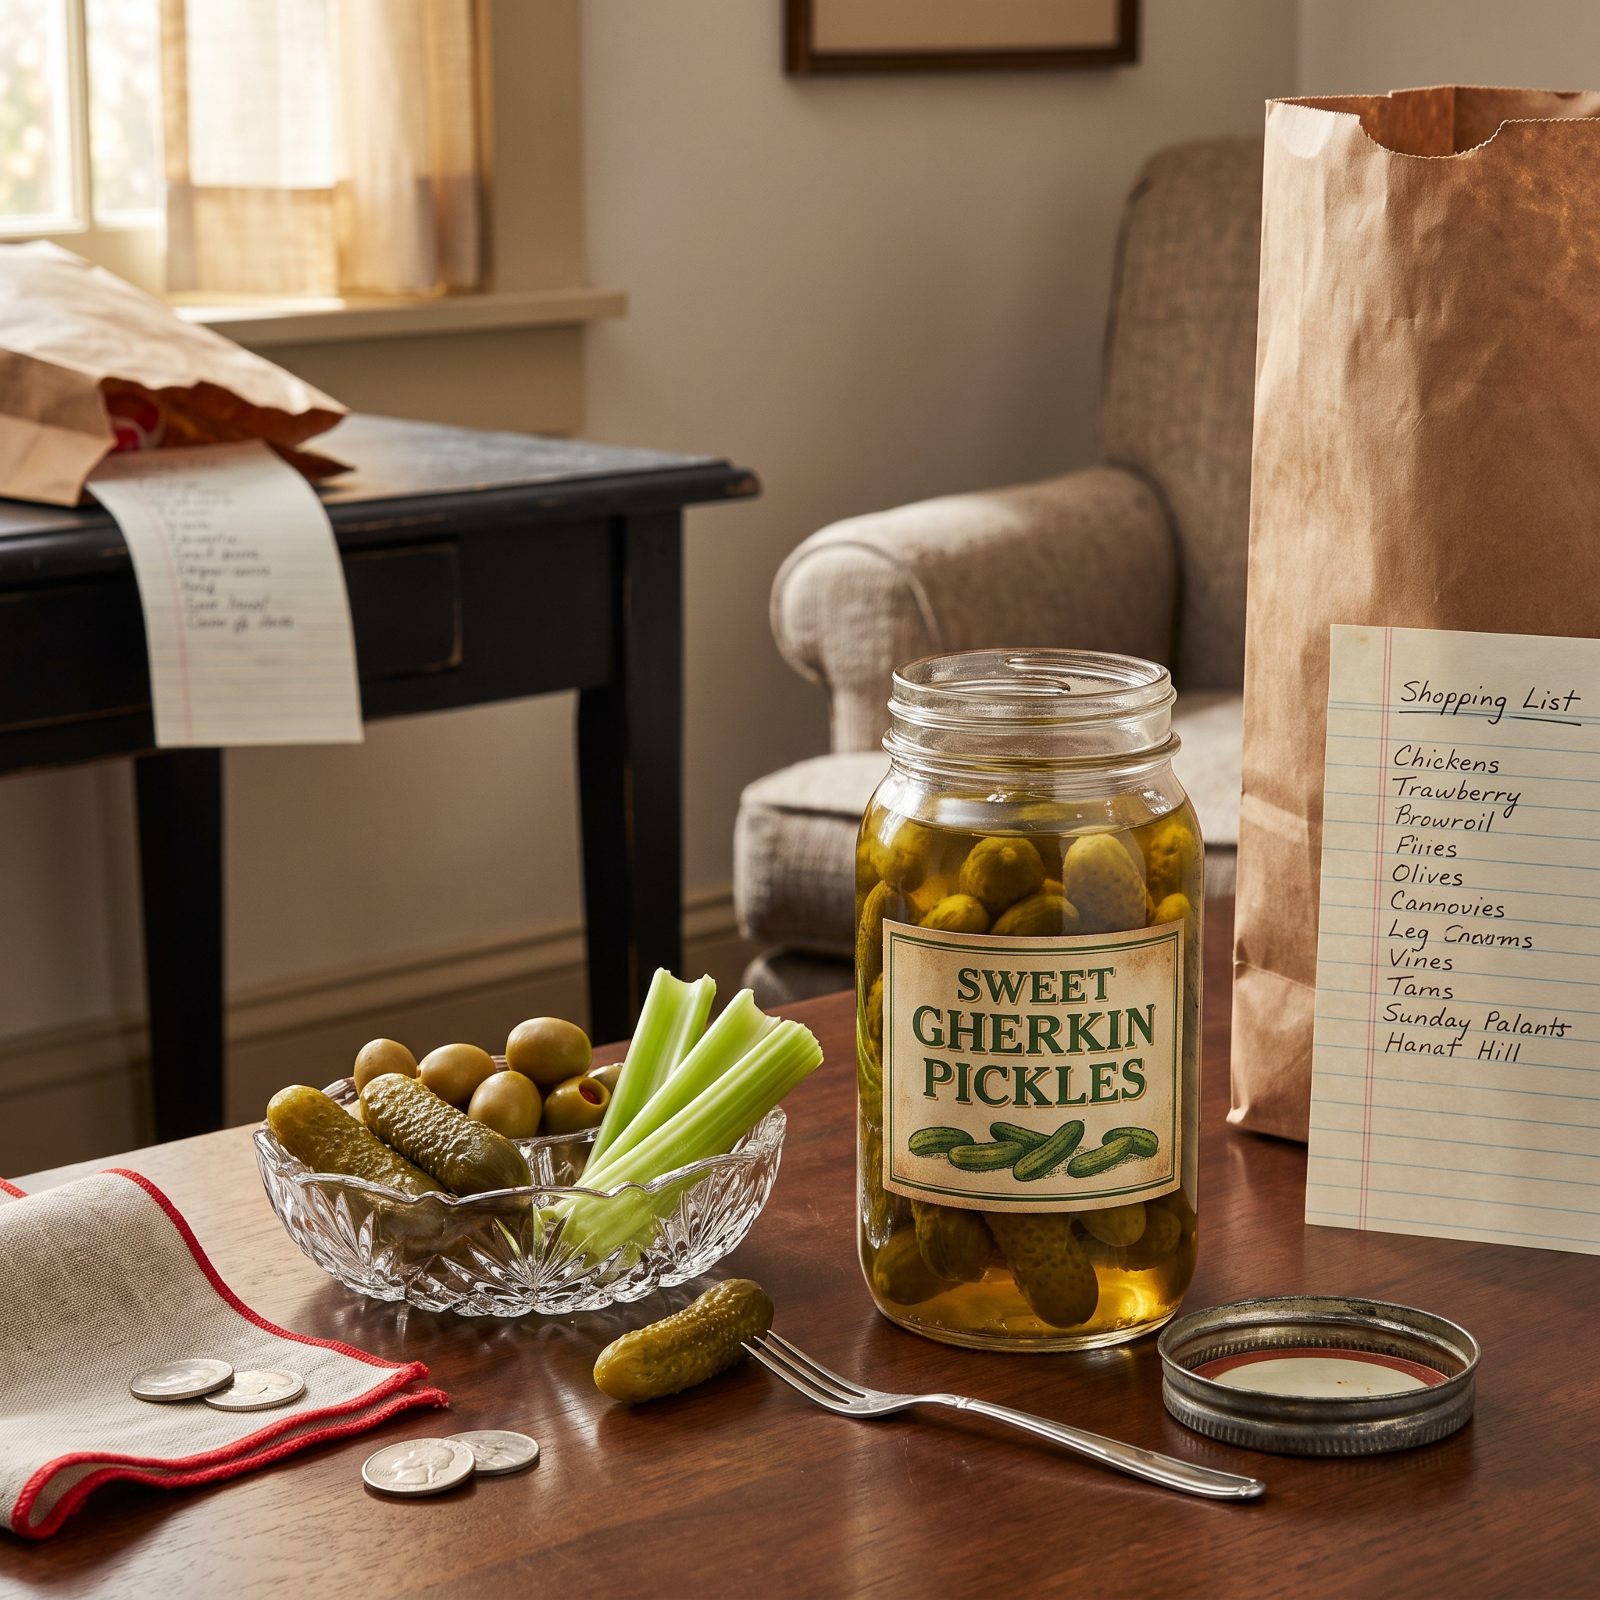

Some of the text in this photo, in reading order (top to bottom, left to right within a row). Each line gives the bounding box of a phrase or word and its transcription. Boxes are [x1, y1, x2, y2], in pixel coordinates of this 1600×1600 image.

[1400, 680, 1582, 725] Shopping List
[1393, 744, 1500, 774] Chickens
[1392, 775, 1522, 819] Trawberry
[1392, 863, 1464, 887] Olives
[1390, 890, 1506, 919] Cannovies
[1388, 918, 1430, 952] Leg
[1390, 948, 1454, 971] Vines
[956, 966, 1117, 1005] SWEET
[911, 1003, 1156, 1056] GHERKIN
[1382, 1002, 1573, 1042] Sunday Palants
[1476, 1039, 1522, 1063] Hill
[922, 1057, 1148, 1109] PICKLES
